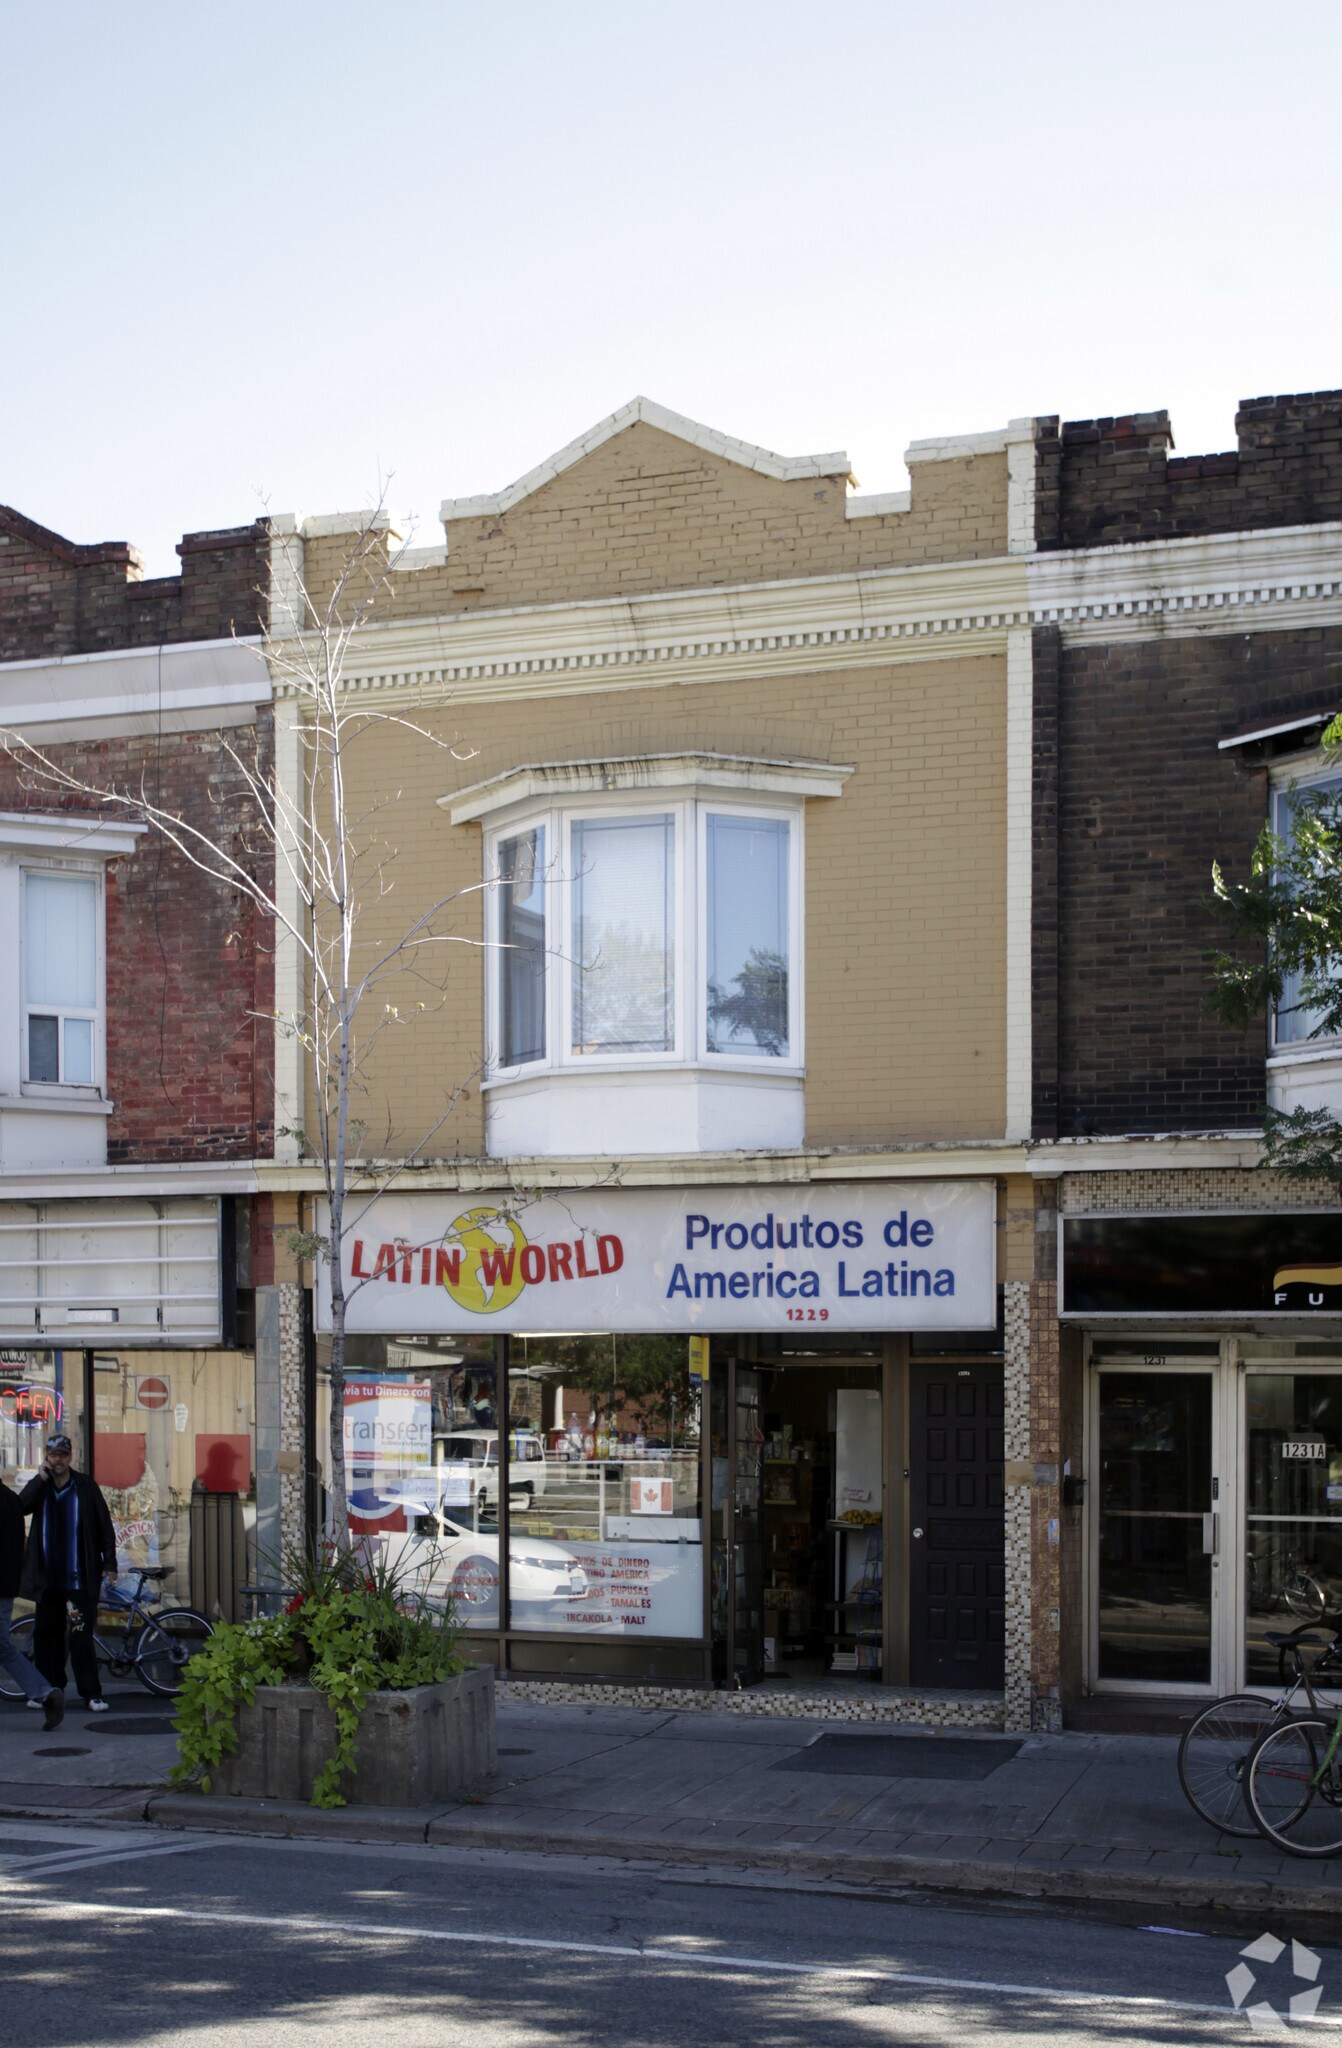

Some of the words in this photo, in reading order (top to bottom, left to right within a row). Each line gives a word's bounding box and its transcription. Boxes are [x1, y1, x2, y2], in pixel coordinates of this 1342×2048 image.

[687, 1213, 864, 1250] Produtos
[883, 1210, 933, 1248] de
[351, 1240, 460, 1286] LATIN
[479, 1233, 625, 1286] WORLD
[665, 1262, 820, 1299] America
[837, 1259, 955, 1298] Latina
[785, 1308, 830, 1321] 1229
[1143, 1355, 1166, 1366] 1231
[343, 1385, 359, 1395] nvía
[362, 1387, 373, 1395] tu
[375, 1385, 408, 1397] Dinero
[411, 1388, 430, 1397] con
[0, 1389, 63, 1422] OPEN
[344, 1418, 428, 1440] transfer
[1284, 1443, 1325, 1458] 1231A
[601, 1557, 613, 1566] DE
[618, 1558, 650, 1568] DINERO
[611, 1569, 650, 1580] AMERICA
[610, 1585, 649, 1596] PUPUSAS
[610, 1598, 651, 1609] TAMALES
